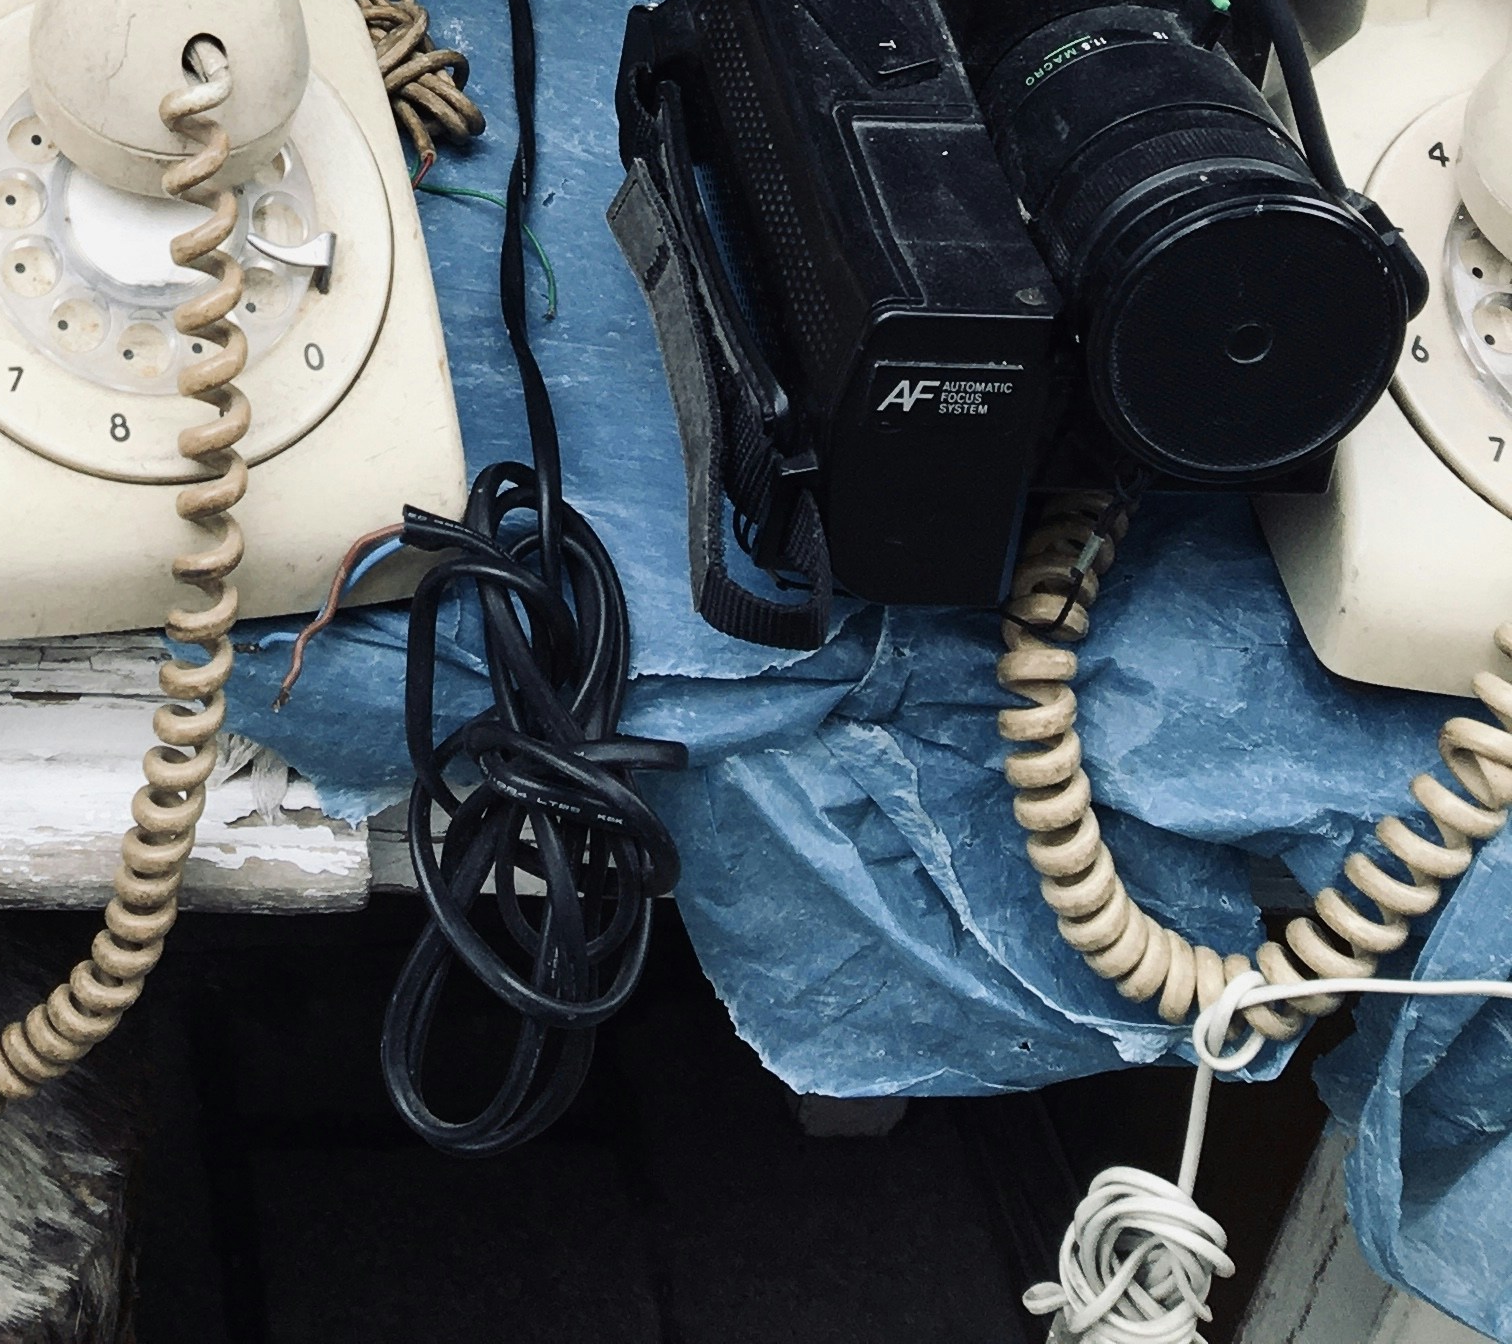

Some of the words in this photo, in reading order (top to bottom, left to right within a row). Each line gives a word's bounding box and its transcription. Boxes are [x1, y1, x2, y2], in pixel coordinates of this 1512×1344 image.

[1025, 47, 1077, 86] MACRO
[1428, 142, 1449, 167] 4
[304, 343, 324, 370] 0
[1412, 335, 1429, 363] 6
[9, 367, 23, 391] 7
[942, 381, 1014, 394] AUTOMATIC
[876, 379, 941, 412] AF
[940, 392, 982, 404] FOCUS
[938, 403, 988, 415] SYSTEM
[110, 413, 130, 442] 8
[1489, 437, 1505, 461] 7
